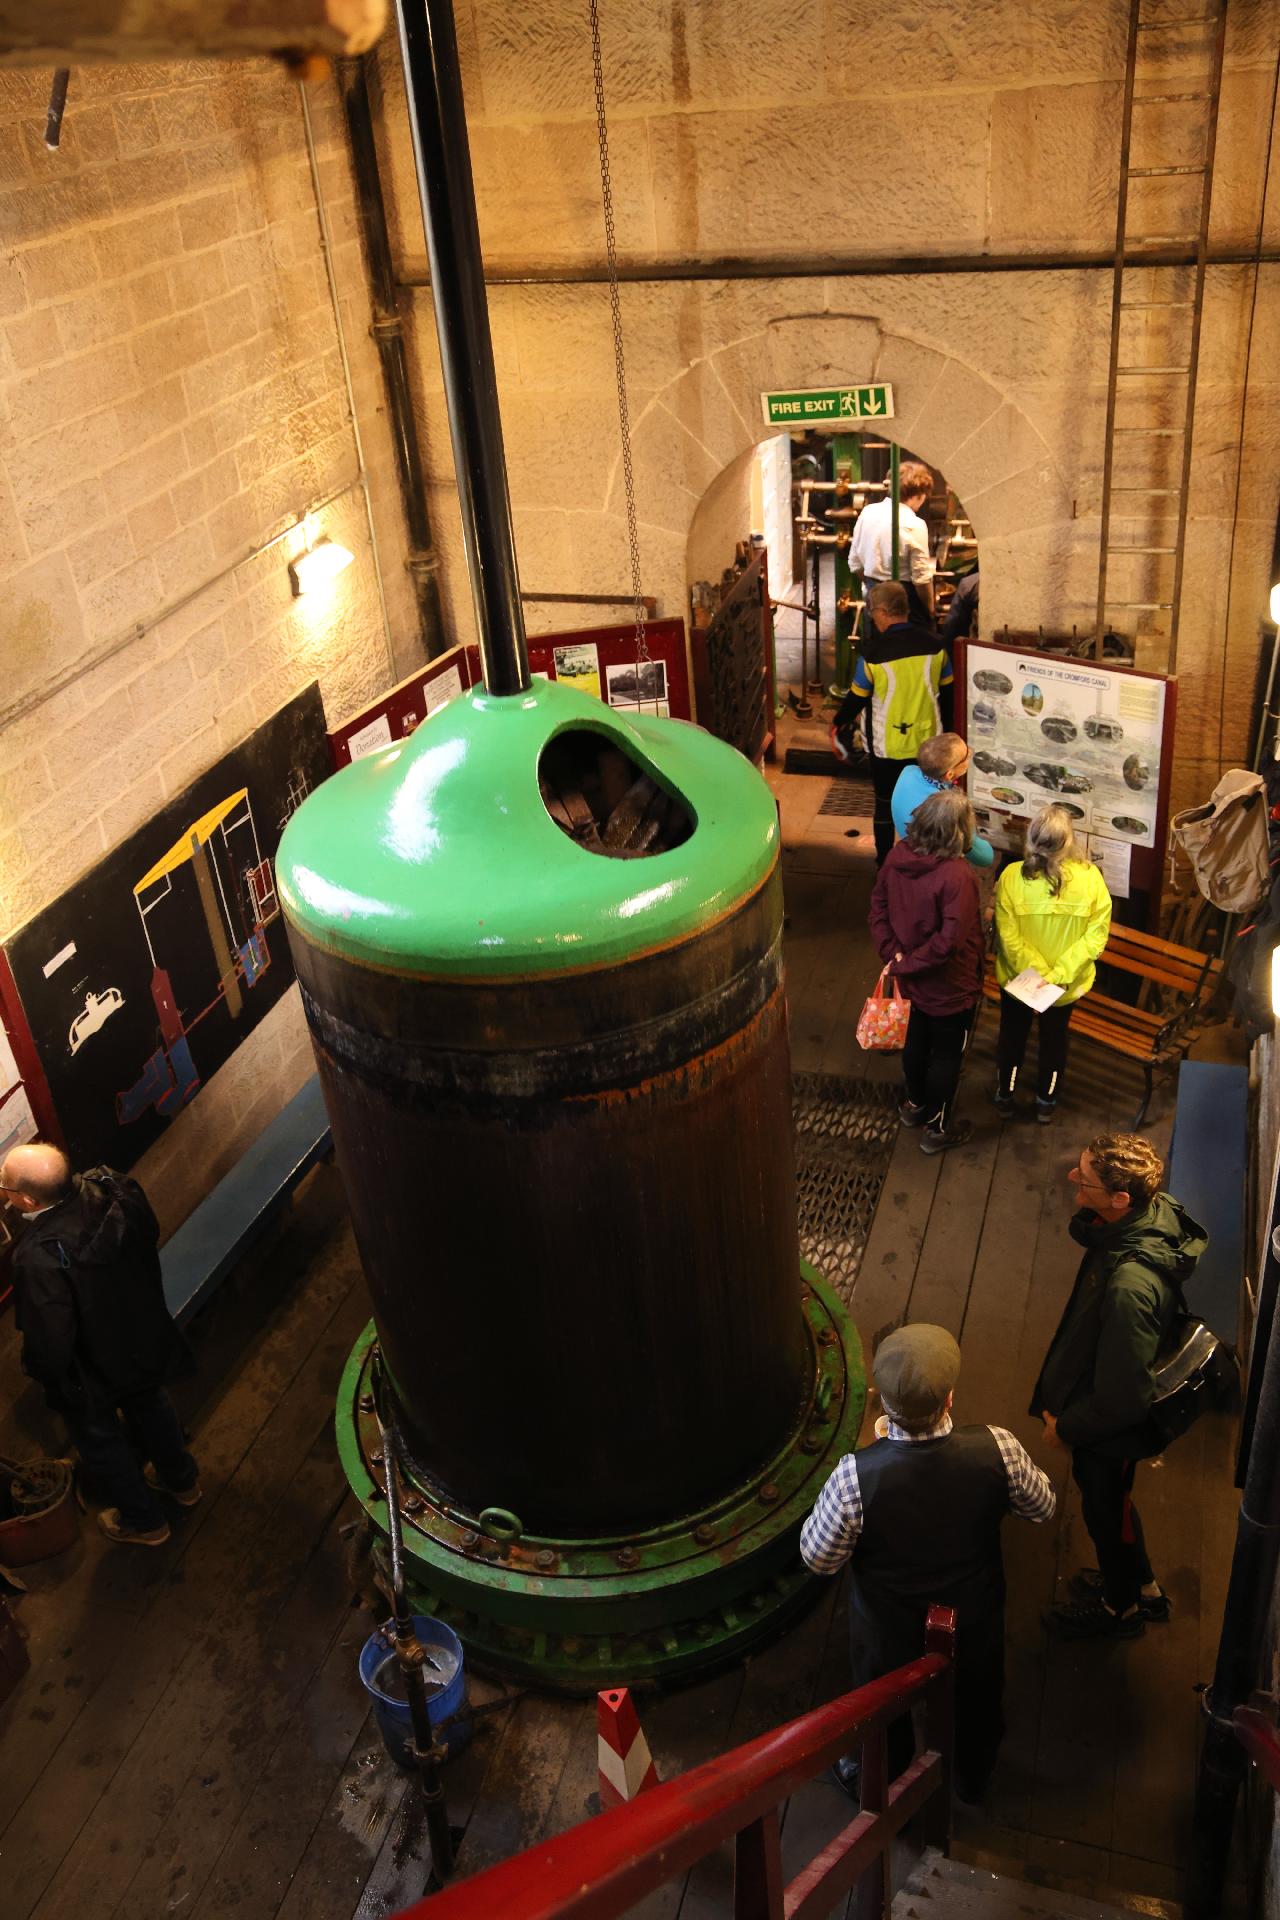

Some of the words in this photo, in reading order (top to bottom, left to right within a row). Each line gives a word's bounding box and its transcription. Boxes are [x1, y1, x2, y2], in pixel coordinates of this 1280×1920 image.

[771, 402, 801, 414] FIRE
[804, 400, 835, 412] EXIT
[1027, 666, 1046, 675] FRIENDS
[1091, 678, 1107, 687] CANAL
